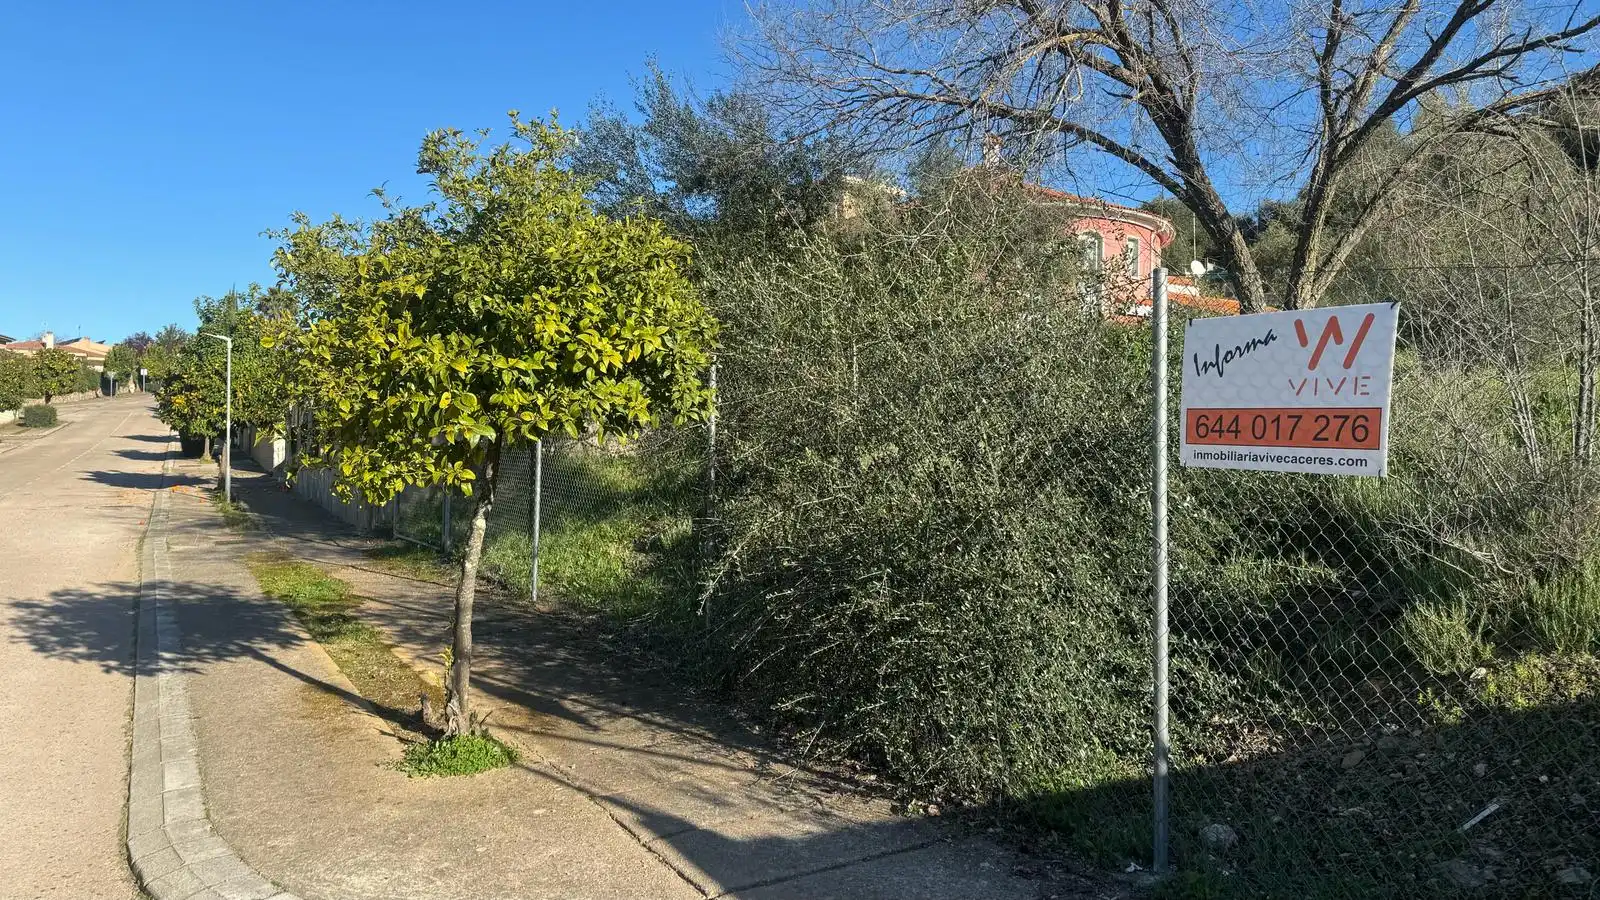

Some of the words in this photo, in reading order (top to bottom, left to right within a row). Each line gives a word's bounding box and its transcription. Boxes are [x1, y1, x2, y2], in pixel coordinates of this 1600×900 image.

[1193, 328, 1278, 378] Informa
[1288, 376, 1371, 396] VIVE
[1195, 414, 1241, 439] 644
[1251, 414, 1303, 441] 017
[1312, 414, 1369, 443] 276
[1193, 450, 1368, 467] inmobiliariavivecaceres.com
